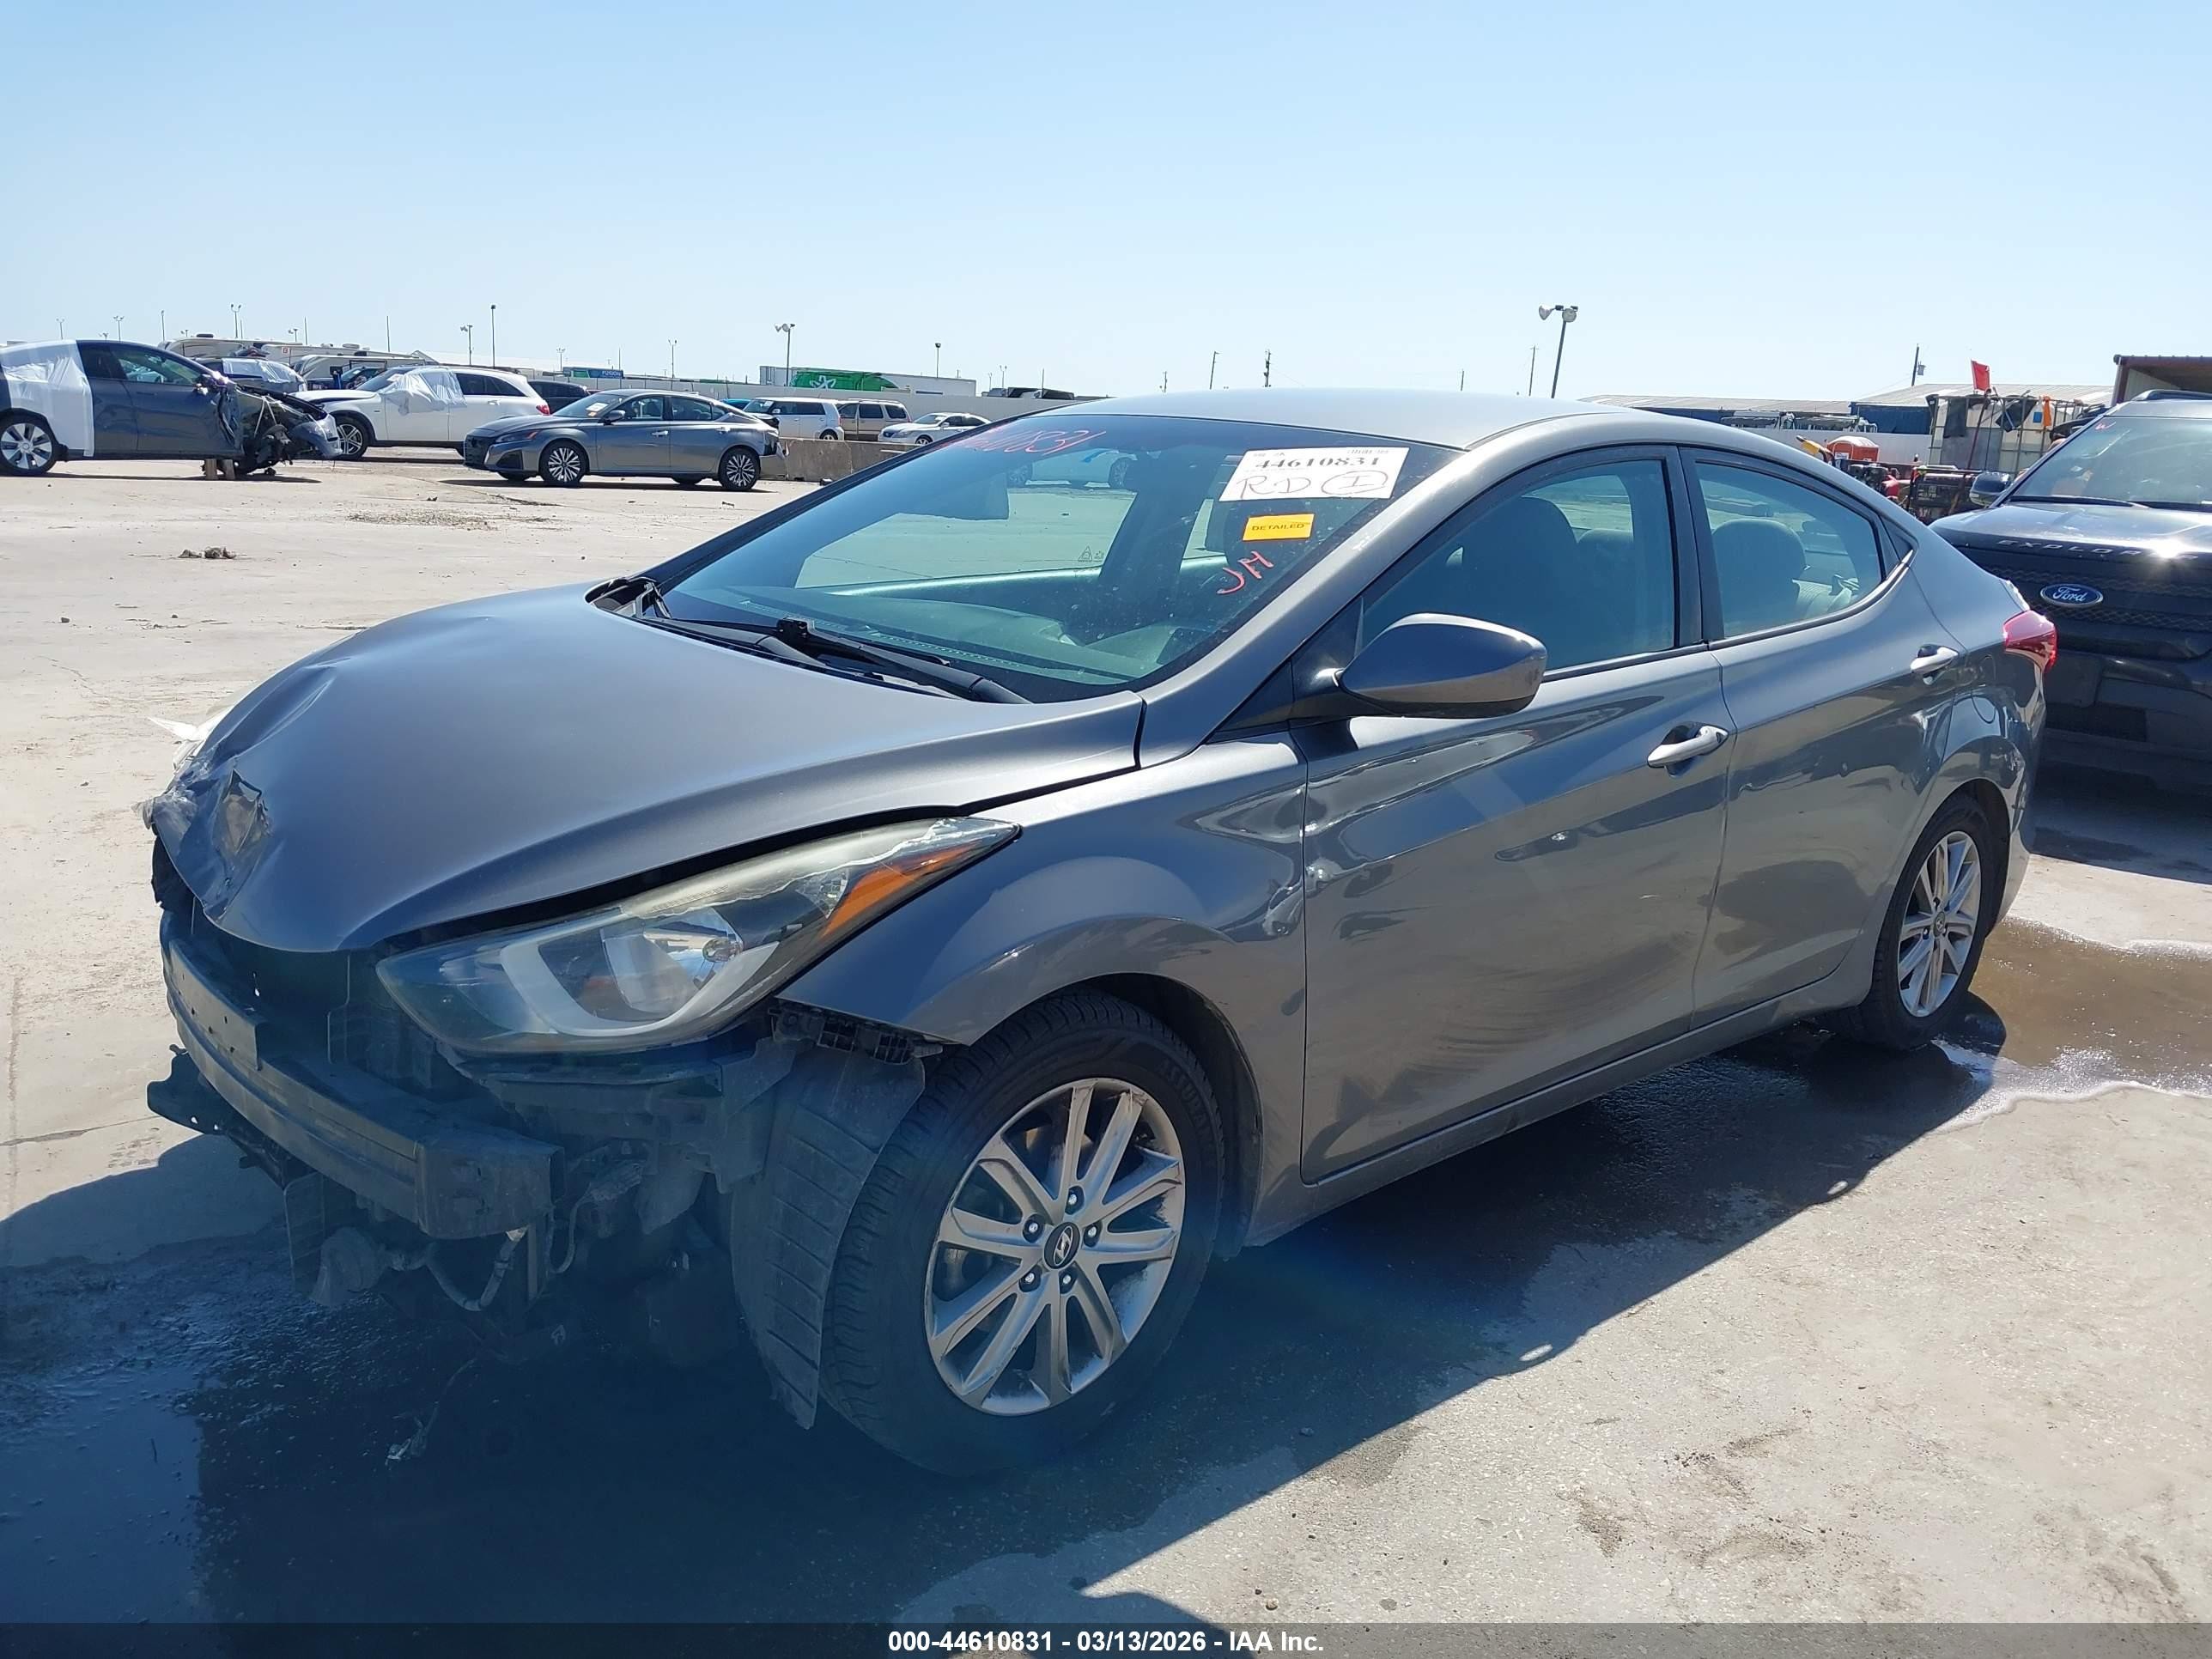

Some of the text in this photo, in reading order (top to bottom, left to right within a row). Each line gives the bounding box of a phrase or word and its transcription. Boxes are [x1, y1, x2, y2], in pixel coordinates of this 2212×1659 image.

[1255, 456, 1379, 470] 44610831
[1251, 522, 1305, 532] DETAILED
[1996, 539, 2199, 560] EXPLORR
[2052, 586, 2088, 603] Ford
